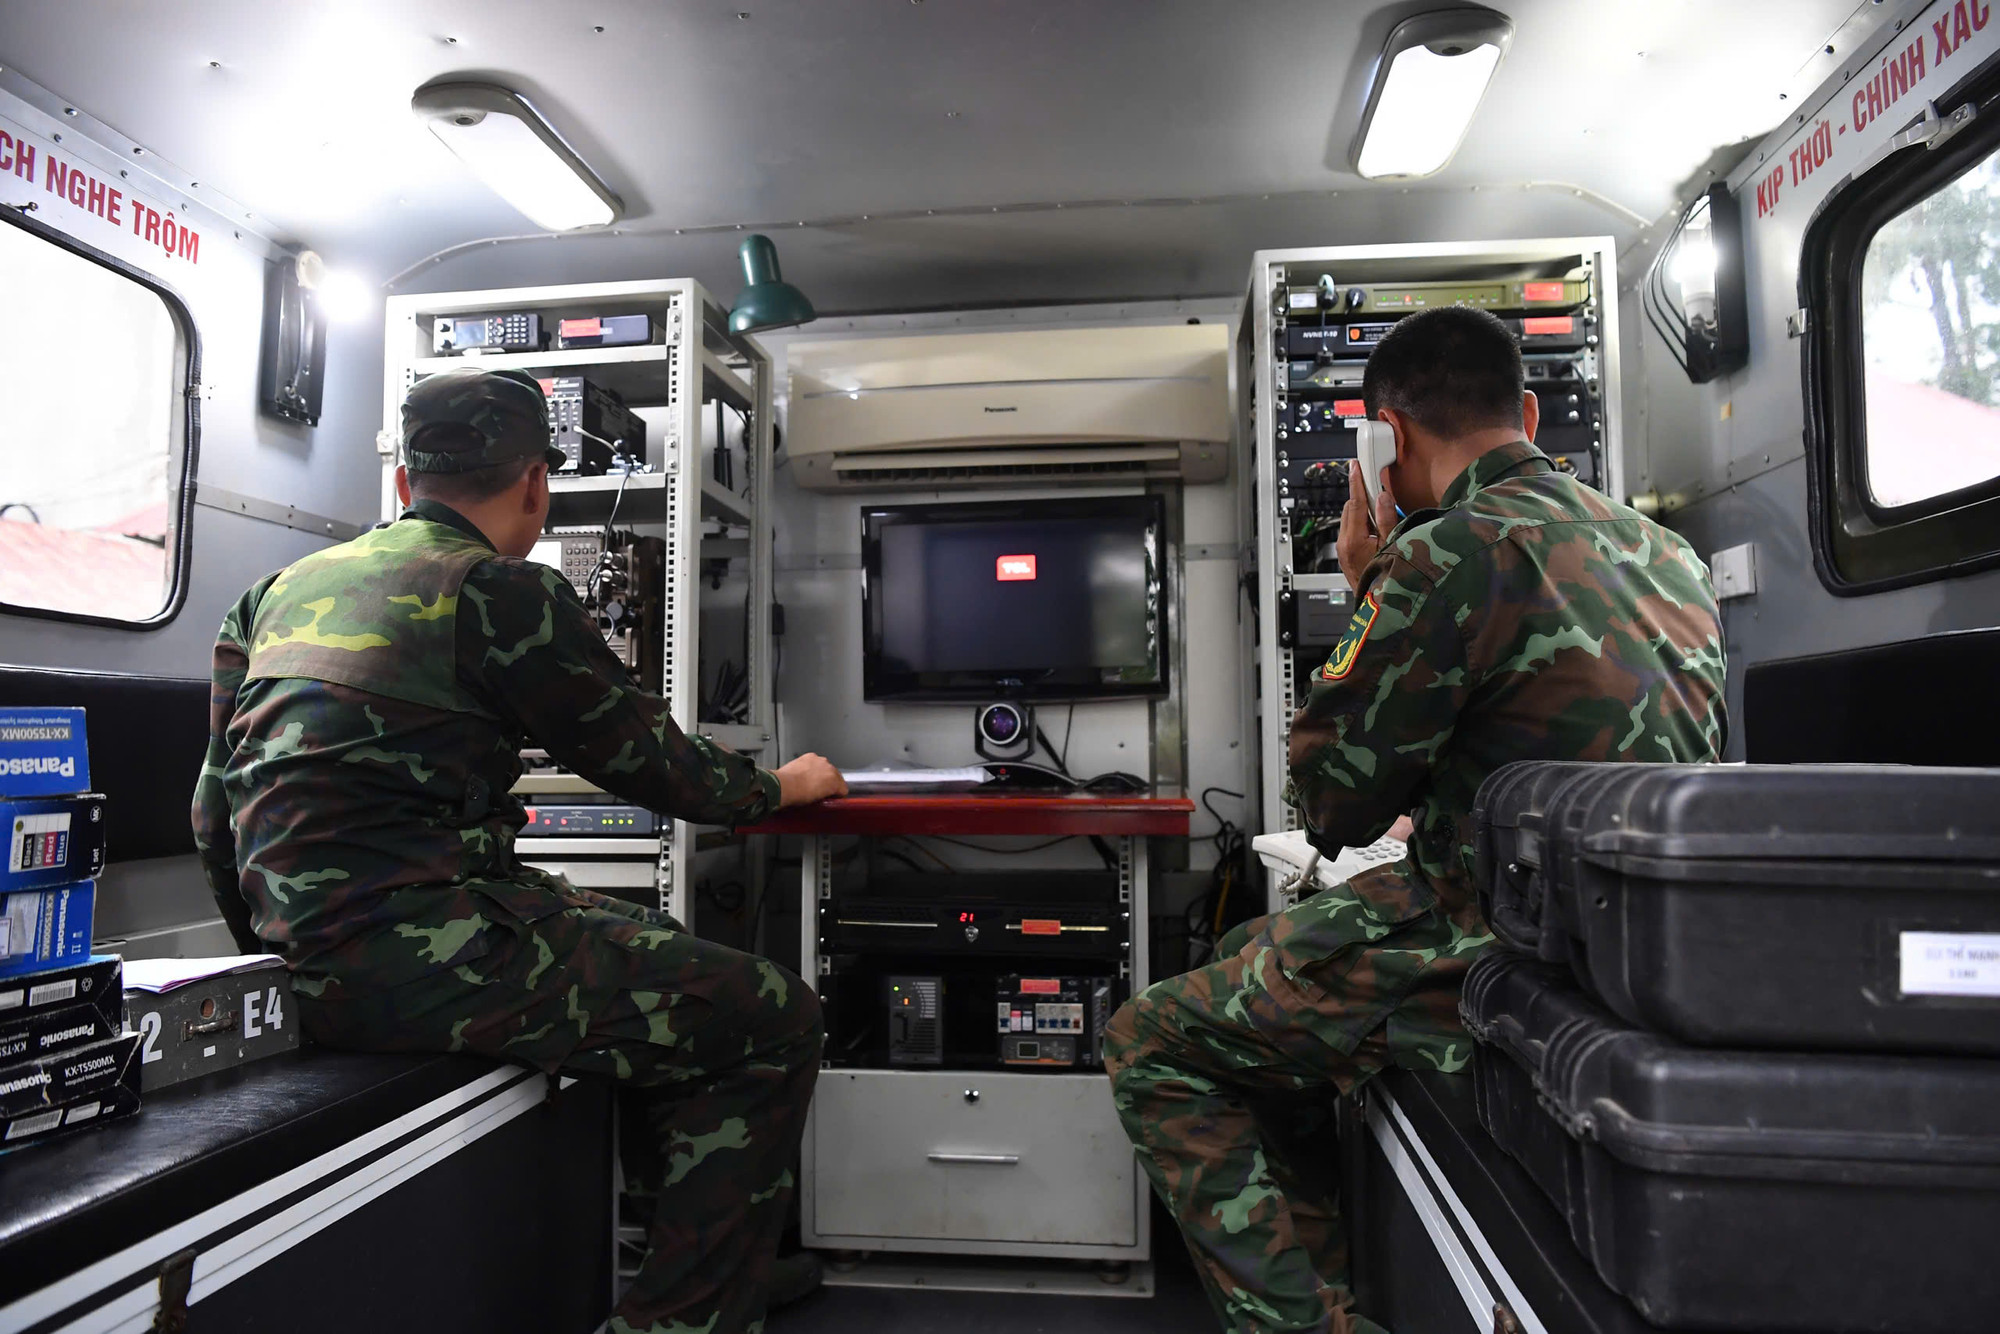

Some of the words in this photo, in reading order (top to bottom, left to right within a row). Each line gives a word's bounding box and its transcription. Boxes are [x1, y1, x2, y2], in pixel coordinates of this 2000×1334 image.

[1756, 165, 1784, 219] KỊP
[1789, 119, 1833, 188] THỜI
[1852, 35, 1926, 133] CHÍNH
[46, 154, 123, 227] NGHE
[131, 199, 200, 265] TRỘM
[1002, 562, 1031, 574] TCL
[13, 836, 22, 867] White
[23, 836, 33, 867] Black
[34, 837, 45, 865] Gray
[45, 836, 55, 863] Red
[56, 834, 66, 862] Blue
[56, 889, 70, 958] Panasonic
[959, 912, 975, 922] 21
[244, 986, 284, 1040] E4
[40, 1023, 95, 1048] Panasonic
